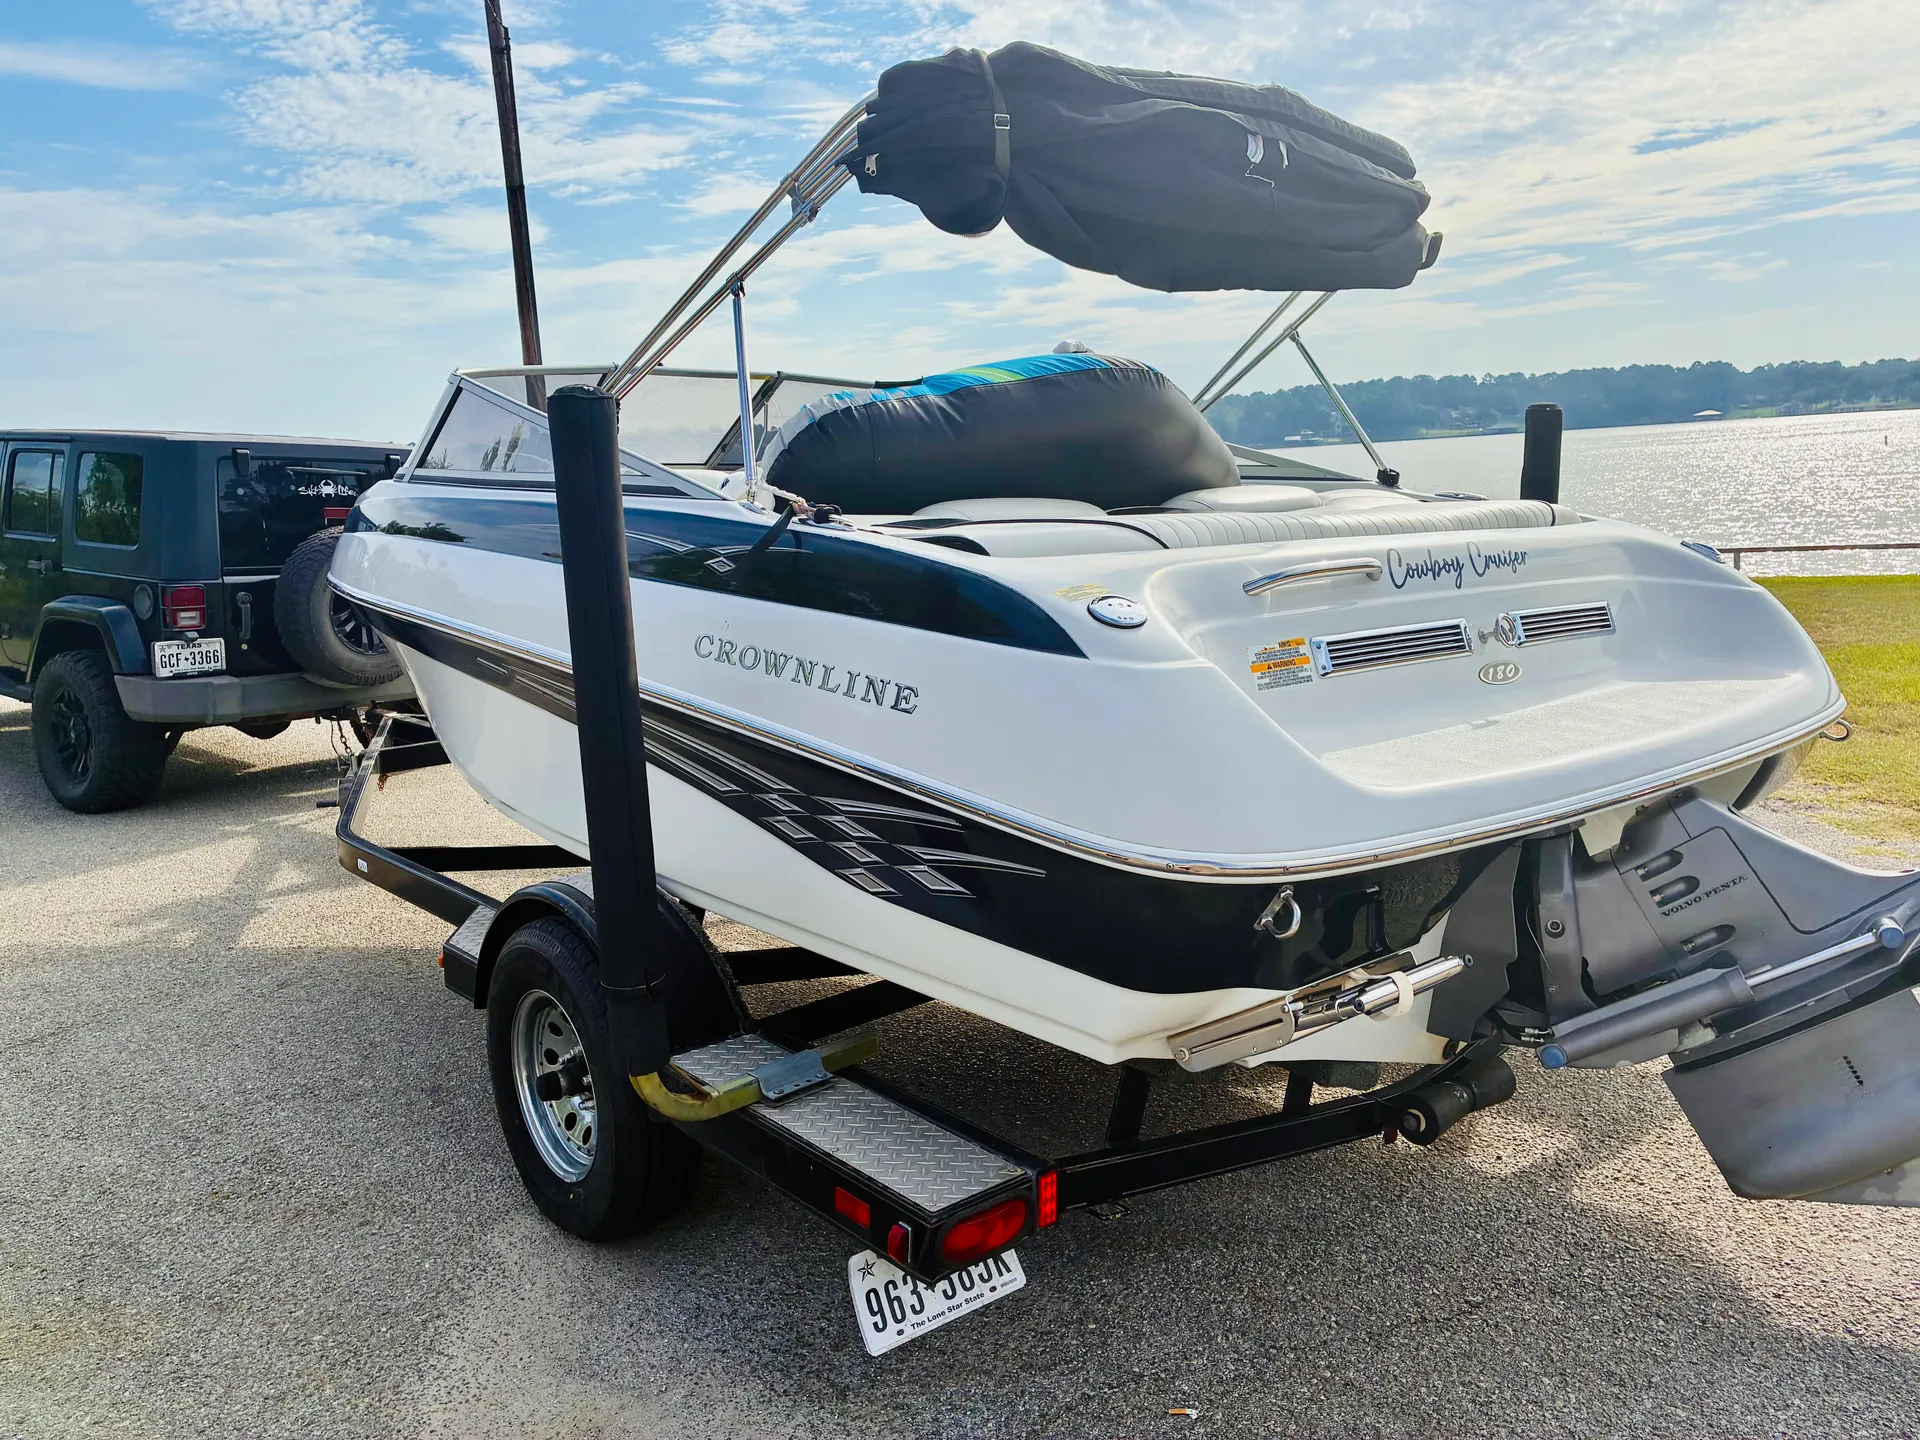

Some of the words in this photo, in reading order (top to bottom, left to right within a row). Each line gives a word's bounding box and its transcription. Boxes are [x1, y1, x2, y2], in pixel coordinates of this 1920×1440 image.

[1387, 548, 1464, 589] Cowboy
[1466, 541, 1527, 577] Cruiser
[160, 652, 182, 668] GCF
[190, 649, 219, 666] 3366
[694, 634, 919, 714] CROWNLINE
[1272, 659, 1296, 669] WARNING
[1488, 664, 1515, 681] 180
[1661, 896, 1702, 917] VOLVO
[1704, 875, 1744, 898] PENTA
[865, 1272, 925, 1333] 963
[911, 1320, 925, 1330] The
[927, 1309, 946, 1323] Lone
[947, 1301, 963, 1314] Star
[964, 1292, 985, 1305] State
